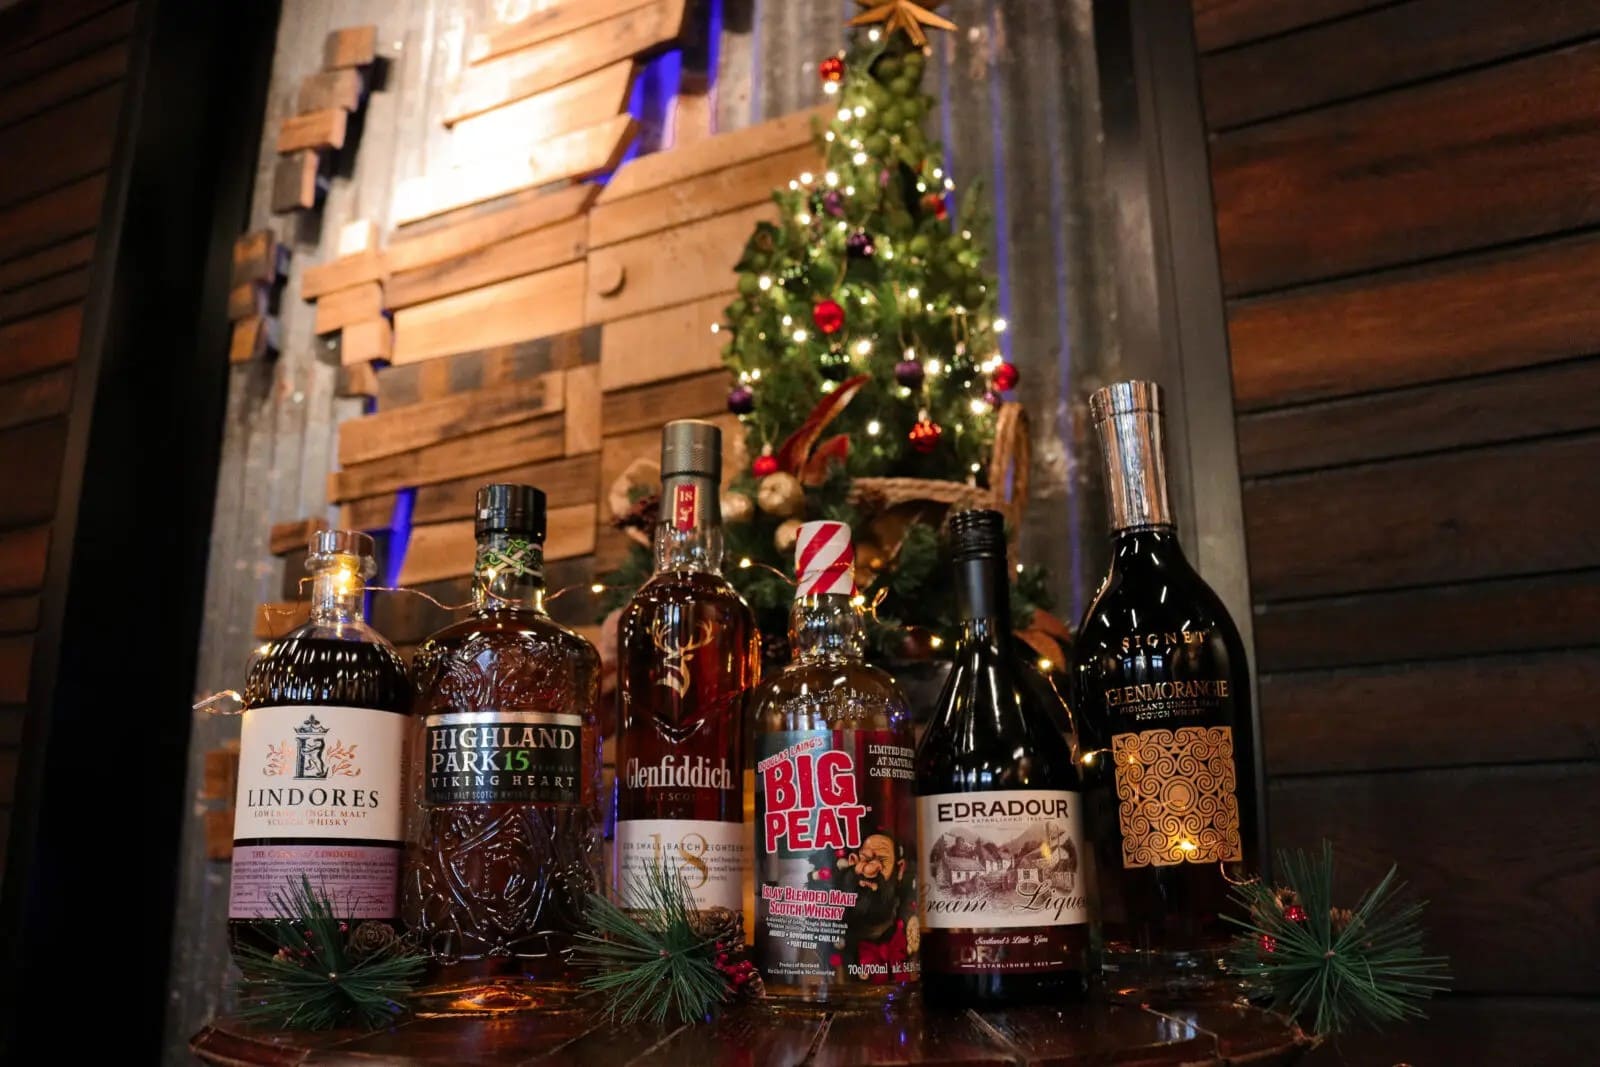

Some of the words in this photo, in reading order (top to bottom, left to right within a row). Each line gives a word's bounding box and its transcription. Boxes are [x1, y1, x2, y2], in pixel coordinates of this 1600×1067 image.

[679, 490, 693, 502] 18
[1122, 631, 1206, 649] SIGNET
[431, 727, 576, 751] HIGHLAND
[758, 748, 790, 773] DOUGLAS
[868, 744, 900, 756] LIMITED
[431, 750, 501, 774] PARK
[504, 750, 531, 771] 15
[626, 754, 732, 790] Glenfiddich
[869, 767, 892, 777] CASK
[876, 757, 888, 766] AT
[431, 775, 500, 788] VIKING
[512, 775, 575, 788] HEART
[762, 750, 858, 813] BIG
[247, 788, 380, 809] LINDORES
[340, 810, 368, 818] MALT
[937, 799, 1069, 823] EDRADOUR
[765, 804, 867, 854] PEAT
[666, 842, 702, 852] BATCH
[762, 883, 785, 901] ISLAY
[785, 886, 829, 905] BLENDED
[828, 889, 858, 908] MALT
[1012, 881, 1087, 921] Lique
[769, 900, 803, 918] SCOTCH
[803, 903, 846, 921] WHISKY
[847, 962, 888, 975] 70cl/700ml
